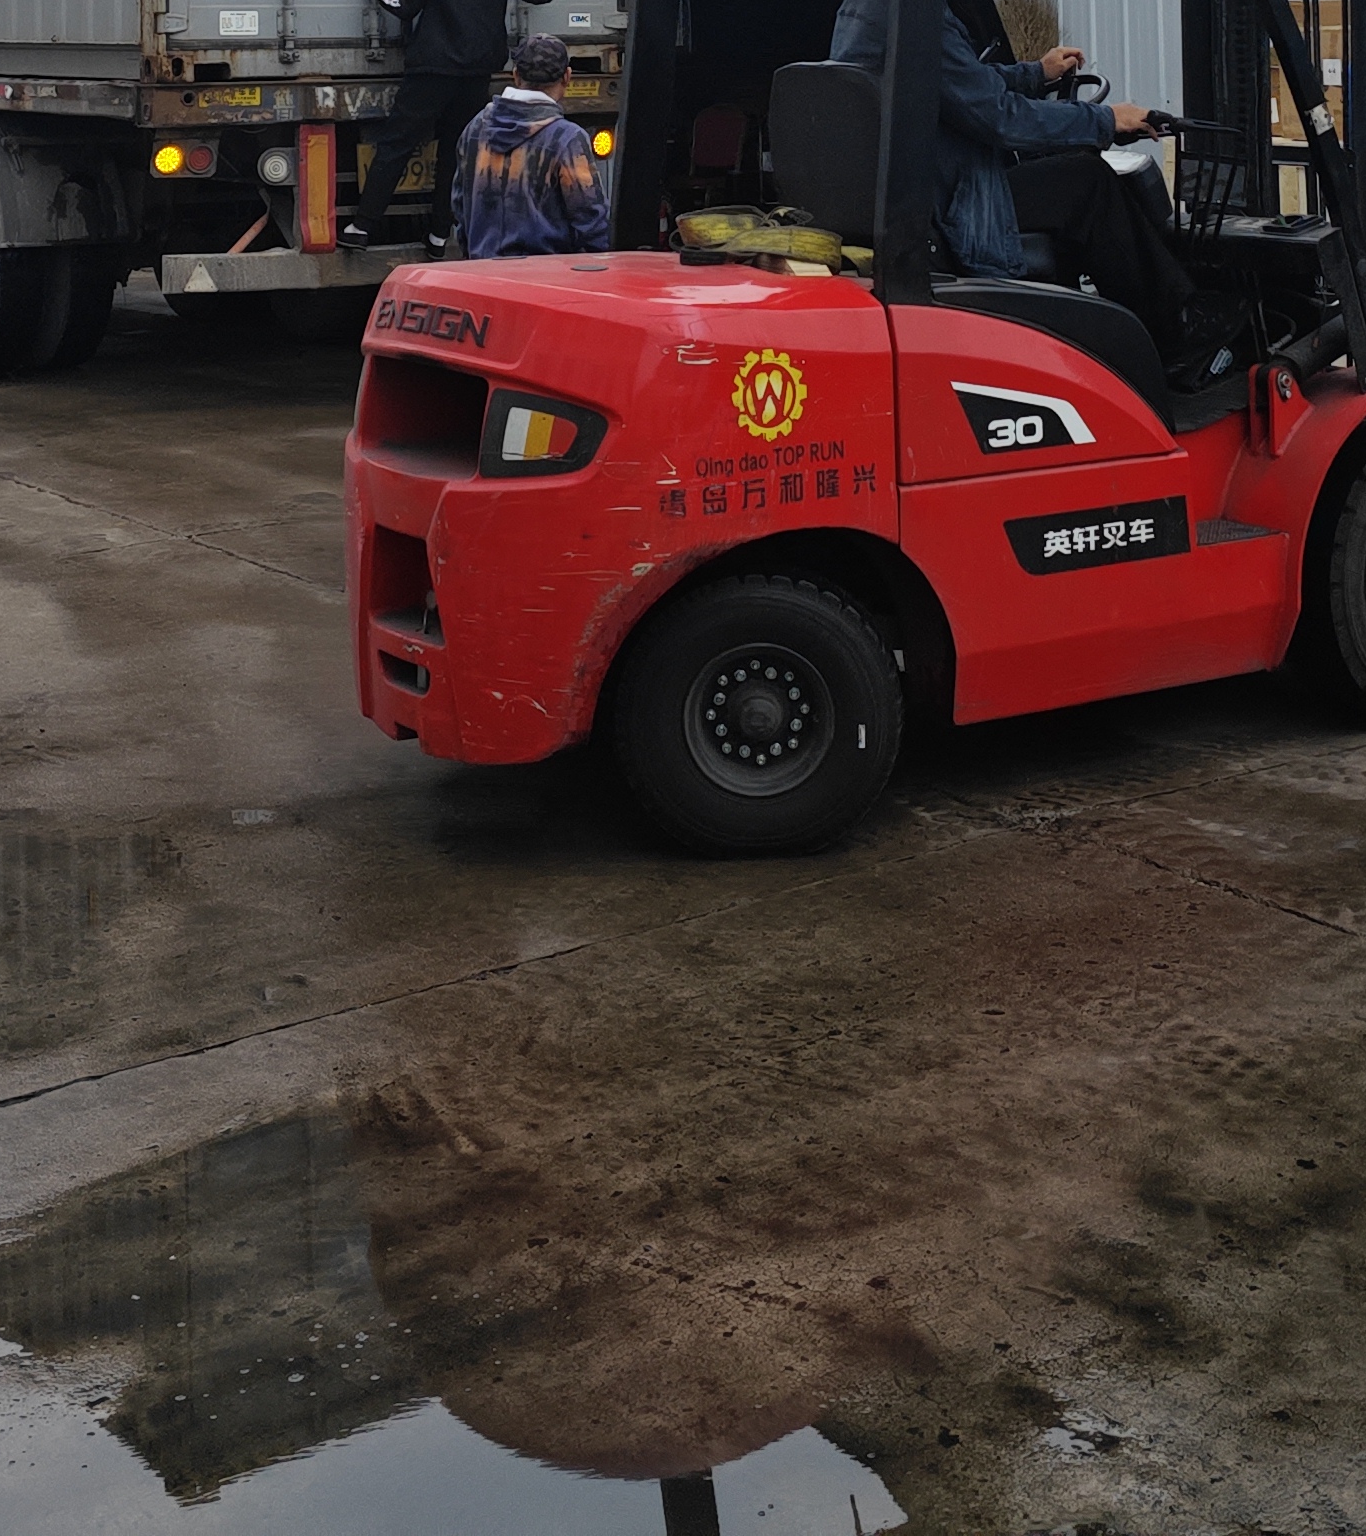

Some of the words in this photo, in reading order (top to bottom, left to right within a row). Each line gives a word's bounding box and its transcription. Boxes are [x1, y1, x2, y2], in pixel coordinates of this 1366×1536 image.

[375, 298, 493, 349] ENSIGN
[987, 415, 1044, 448] 30
[738, 452, 769, 472] dao
[773, 444, 805, 466] TOP
[809, 440, 845, 463] RUN
[1042, 518, 1156, 559] 英轩叉车
